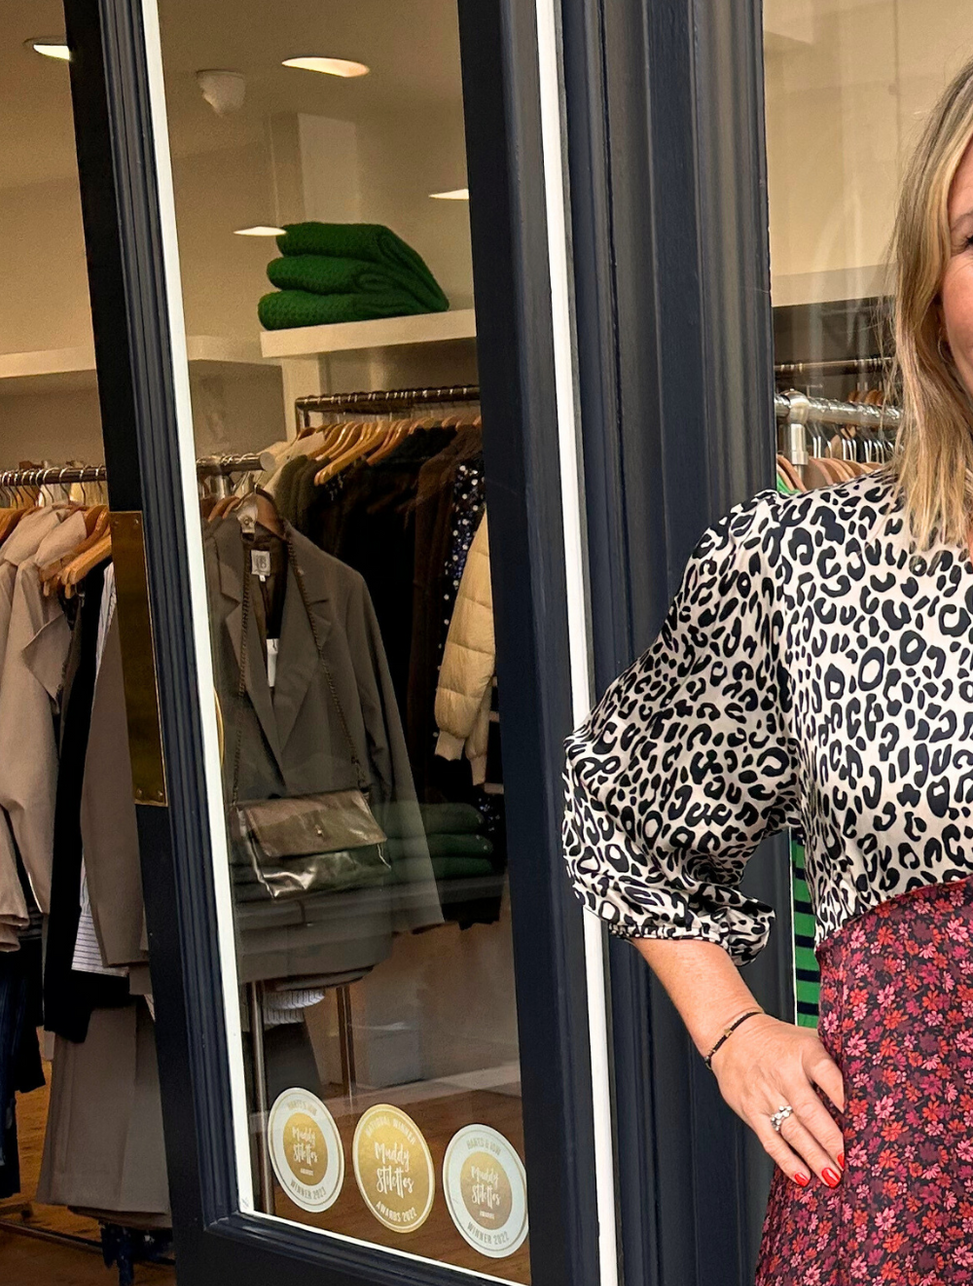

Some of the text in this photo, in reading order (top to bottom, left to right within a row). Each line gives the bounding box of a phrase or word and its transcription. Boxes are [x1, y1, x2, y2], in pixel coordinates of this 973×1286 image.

[374, 1142, 409, 1172] Muddy
[376, 1165, 414, 1199] Stilettos
[471, 1165, 499, 1190] Muddy
[472, 1183, 500, 1210] Stilettos
[375, 1201, 417, 1223] AWARDS 2022
[467, 1221, 509, 1245] WINNER 2022
